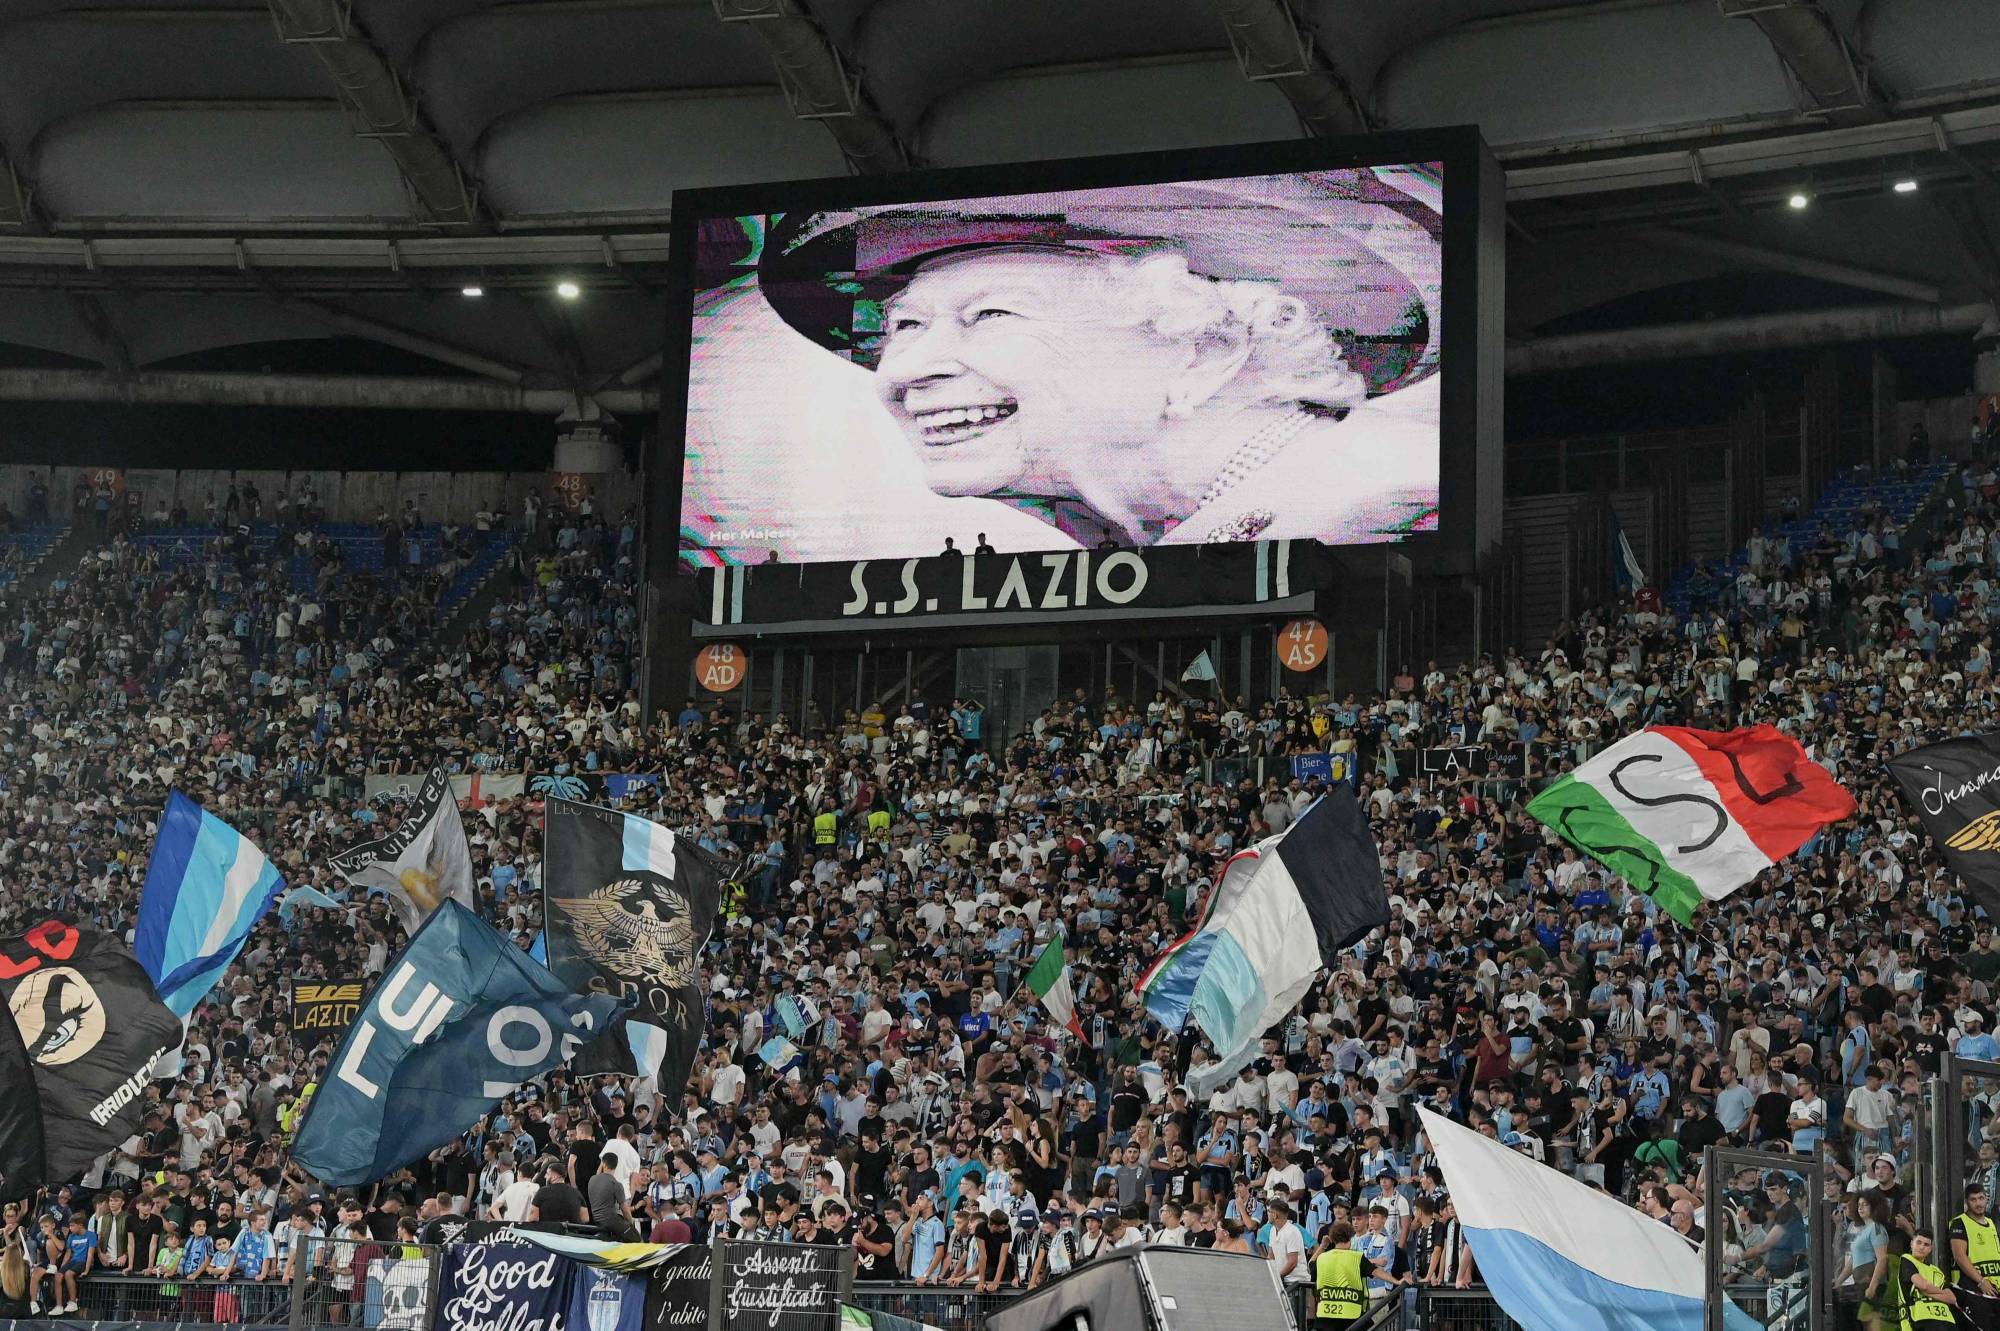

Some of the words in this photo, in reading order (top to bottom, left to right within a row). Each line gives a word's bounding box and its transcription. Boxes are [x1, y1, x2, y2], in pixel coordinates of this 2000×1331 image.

[94, 470, 115, 486] 49
[560, 475, 580, 491] 48
[709, 531, 737, 542] Her
[843, 556, 937, 616] S.S.
[961, 549, 1149, 610] LAZIO
[1290, 620, 1315, 641] 47
[709, 644, 734, 663] 48
[1288, 643, 1315, 666] AS
[704, 665, 735, 685] AD
[1301, 757, 1325, 770] Bier-
[1302, 770, 1327, 783] Zne
[294, 1004, 360, 1030] LAZIO
[734, 1247, 820, 1275] Assenti
[454, 1245, 557, 1303] Good
[595, 1291, 615, 1300] 1974
[657, 1301, 708, 1325] l'abito
[1324, 1303, 1343, 1315] 322
